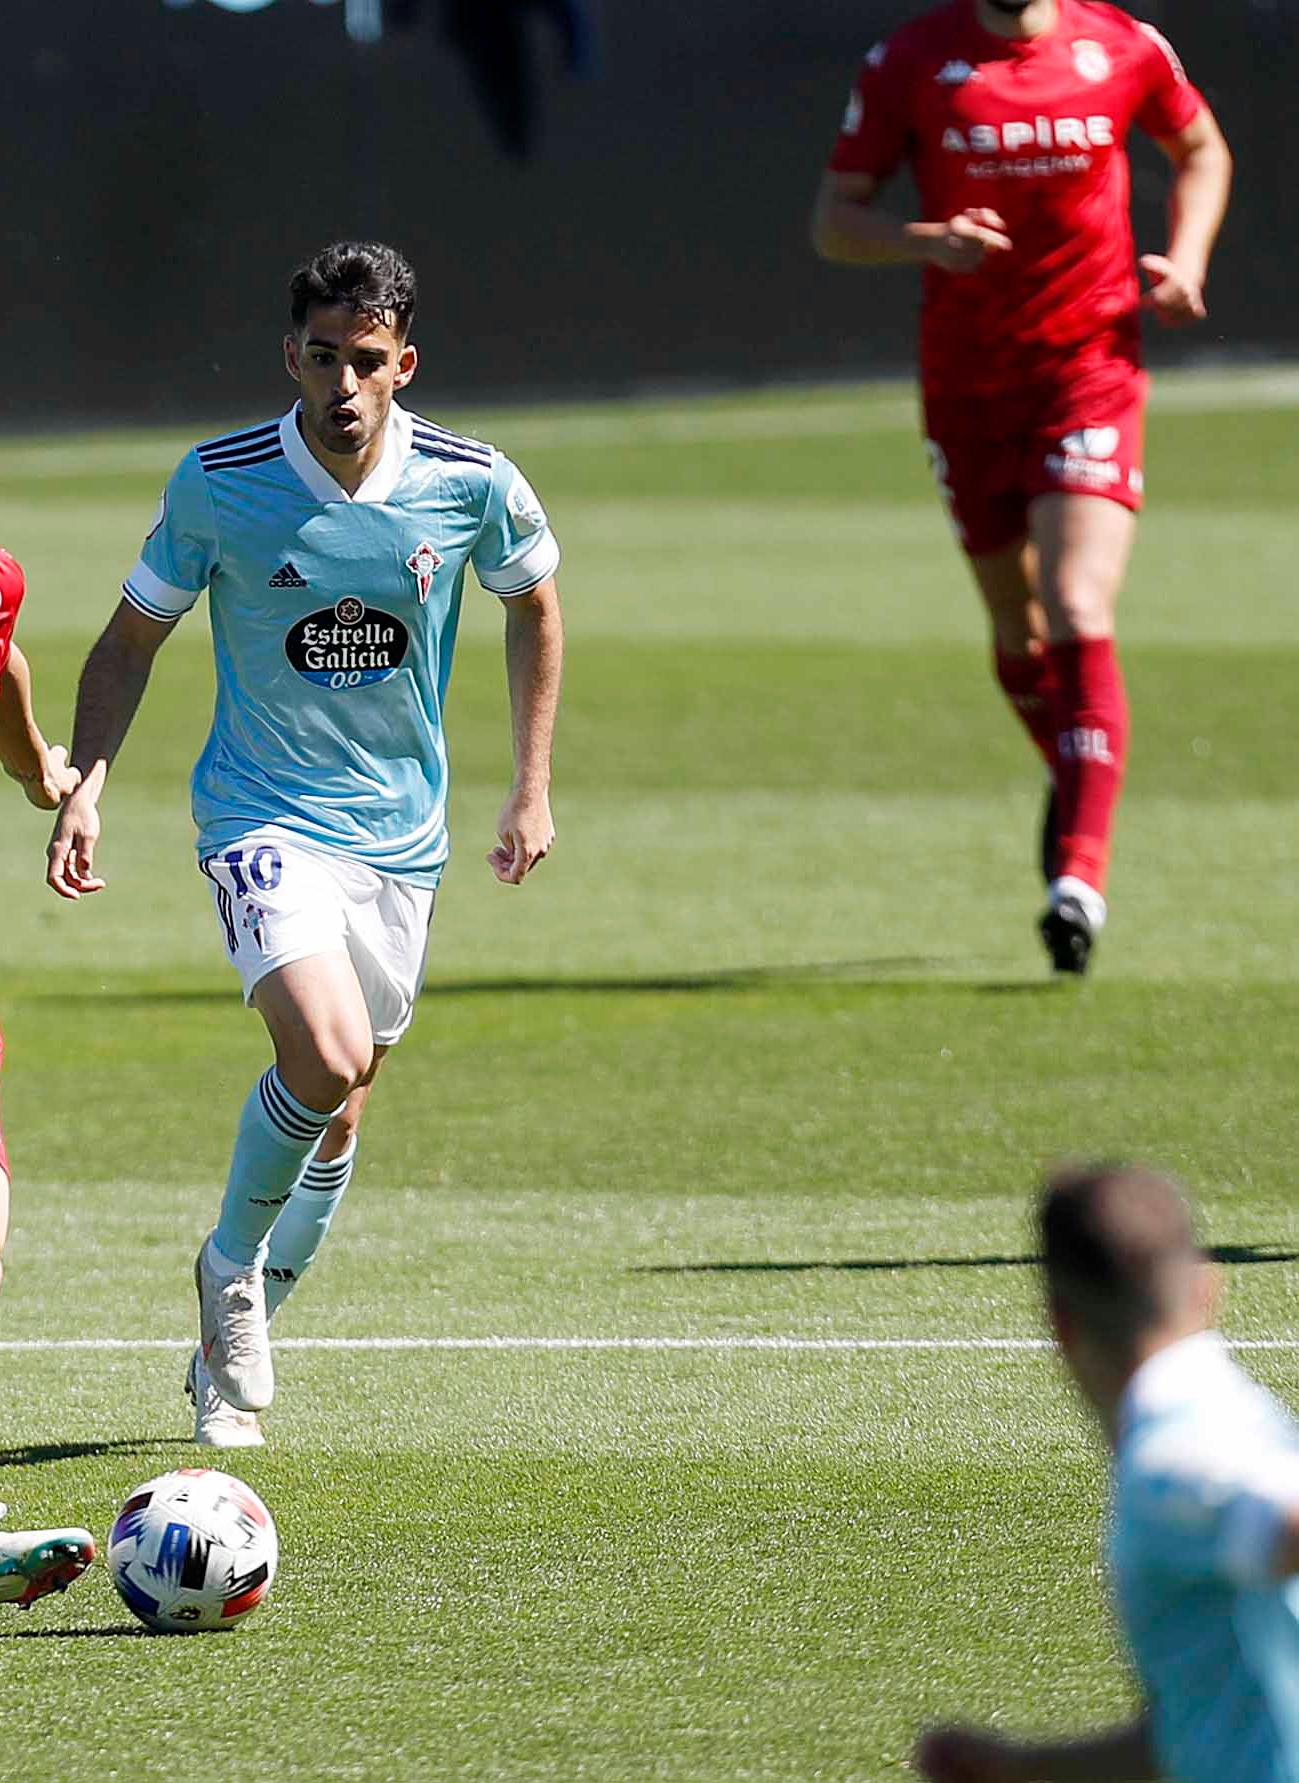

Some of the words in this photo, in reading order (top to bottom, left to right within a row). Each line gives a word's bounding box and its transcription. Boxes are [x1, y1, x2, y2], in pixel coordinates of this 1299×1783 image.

[941, 115, 1114, 152] ASPIRE
[301, 622, 394, 646] Estrella
[305, 646, 390, 670] Galicia
[224, 846, 282, 899] 10
